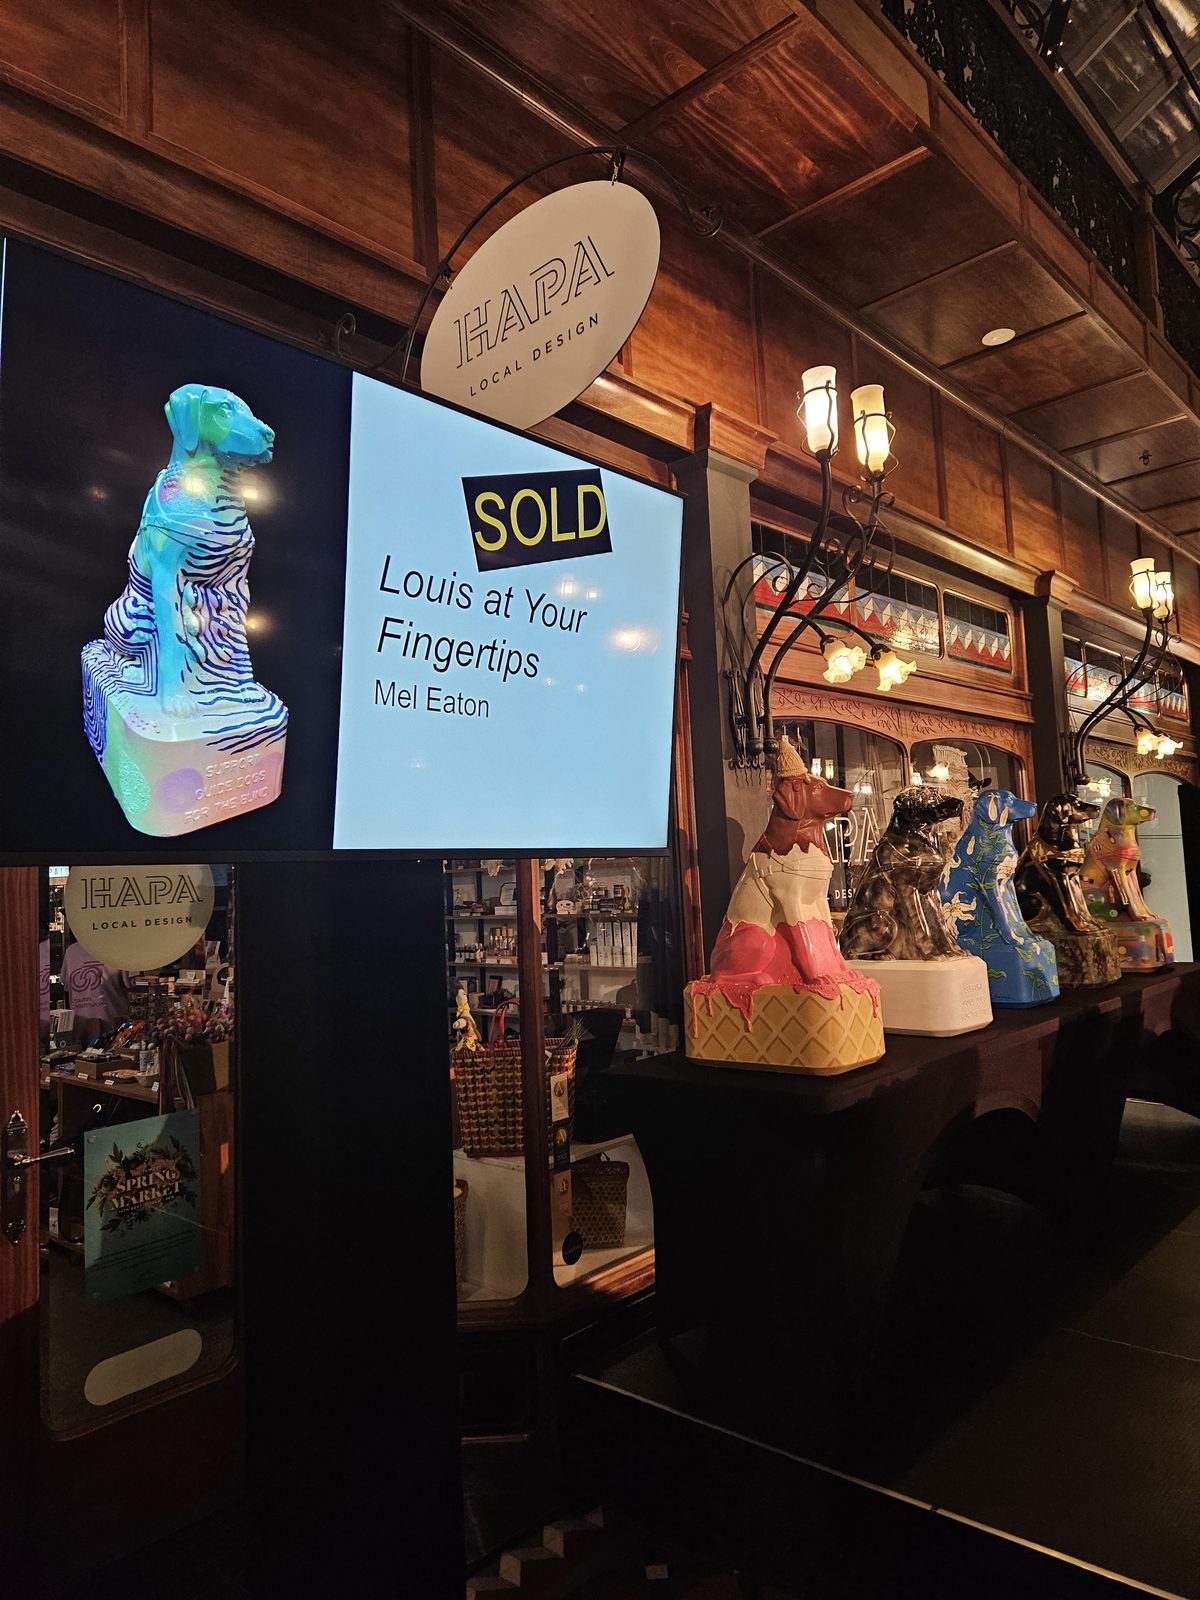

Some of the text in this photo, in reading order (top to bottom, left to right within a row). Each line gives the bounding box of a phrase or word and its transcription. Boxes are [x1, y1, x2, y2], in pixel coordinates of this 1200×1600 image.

[453, 235, 615, 369] HAPA
[470, 312, 600, 397] LOCAL DESIGN
[474, 484, 607, 552] SOLD
[379, 554, 588, 634] Louis at Your
[376, 616, 540, 682] Fingertips
[374, 679, 490, 718] Mel Eaton
[194, 769, 267, 801] GUIDE DOGS
[205, 752, 261, 779] SUPPORT
[183, 786, 270, 825] FOR THE BLIND
[81, 874, 204, 910] HAPA
[92, 916, 193, 931] LOCAL DESIGN
[110, 1180, 181, 1211] MARKET
[115, 1168, 177, 1195] SPRING
